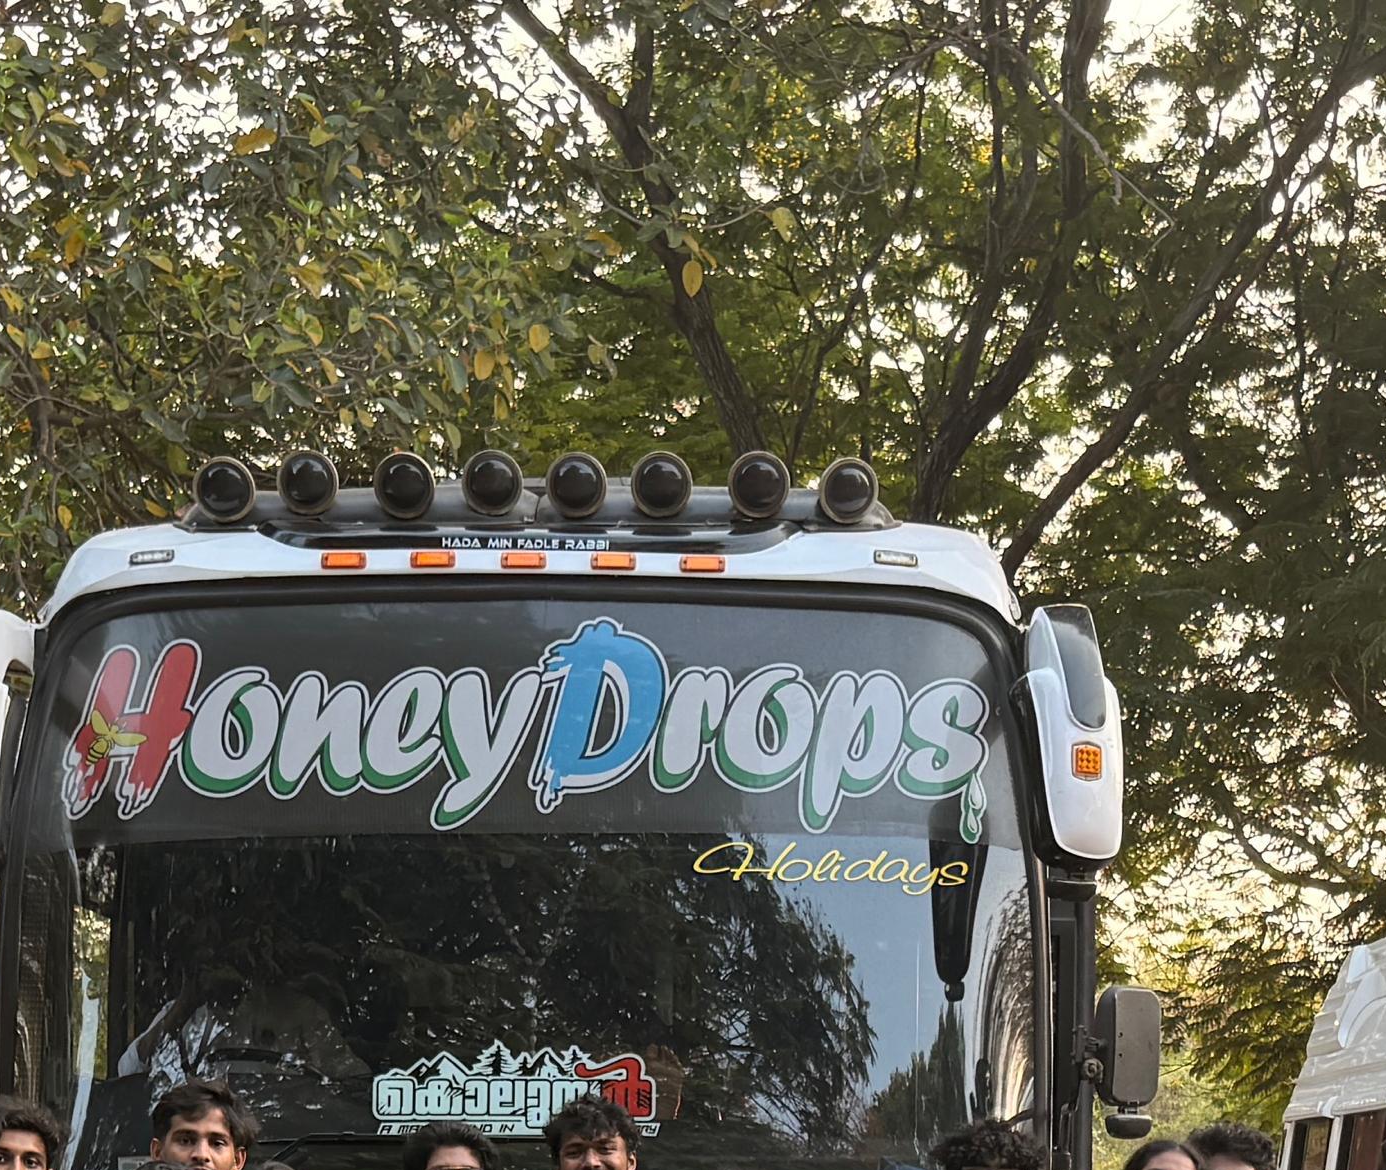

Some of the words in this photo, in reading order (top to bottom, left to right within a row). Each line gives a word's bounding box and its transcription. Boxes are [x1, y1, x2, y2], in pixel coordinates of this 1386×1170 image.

[442, 537, 481, 548] HADA
[487, 538, 512, 549] MIN
[517, 539, 559, 550] FADLE
[565, 540, 610, 550] RABBI
[693, 841, 969, 895] Holidays
[499, 1123, 515, 1133] IN
